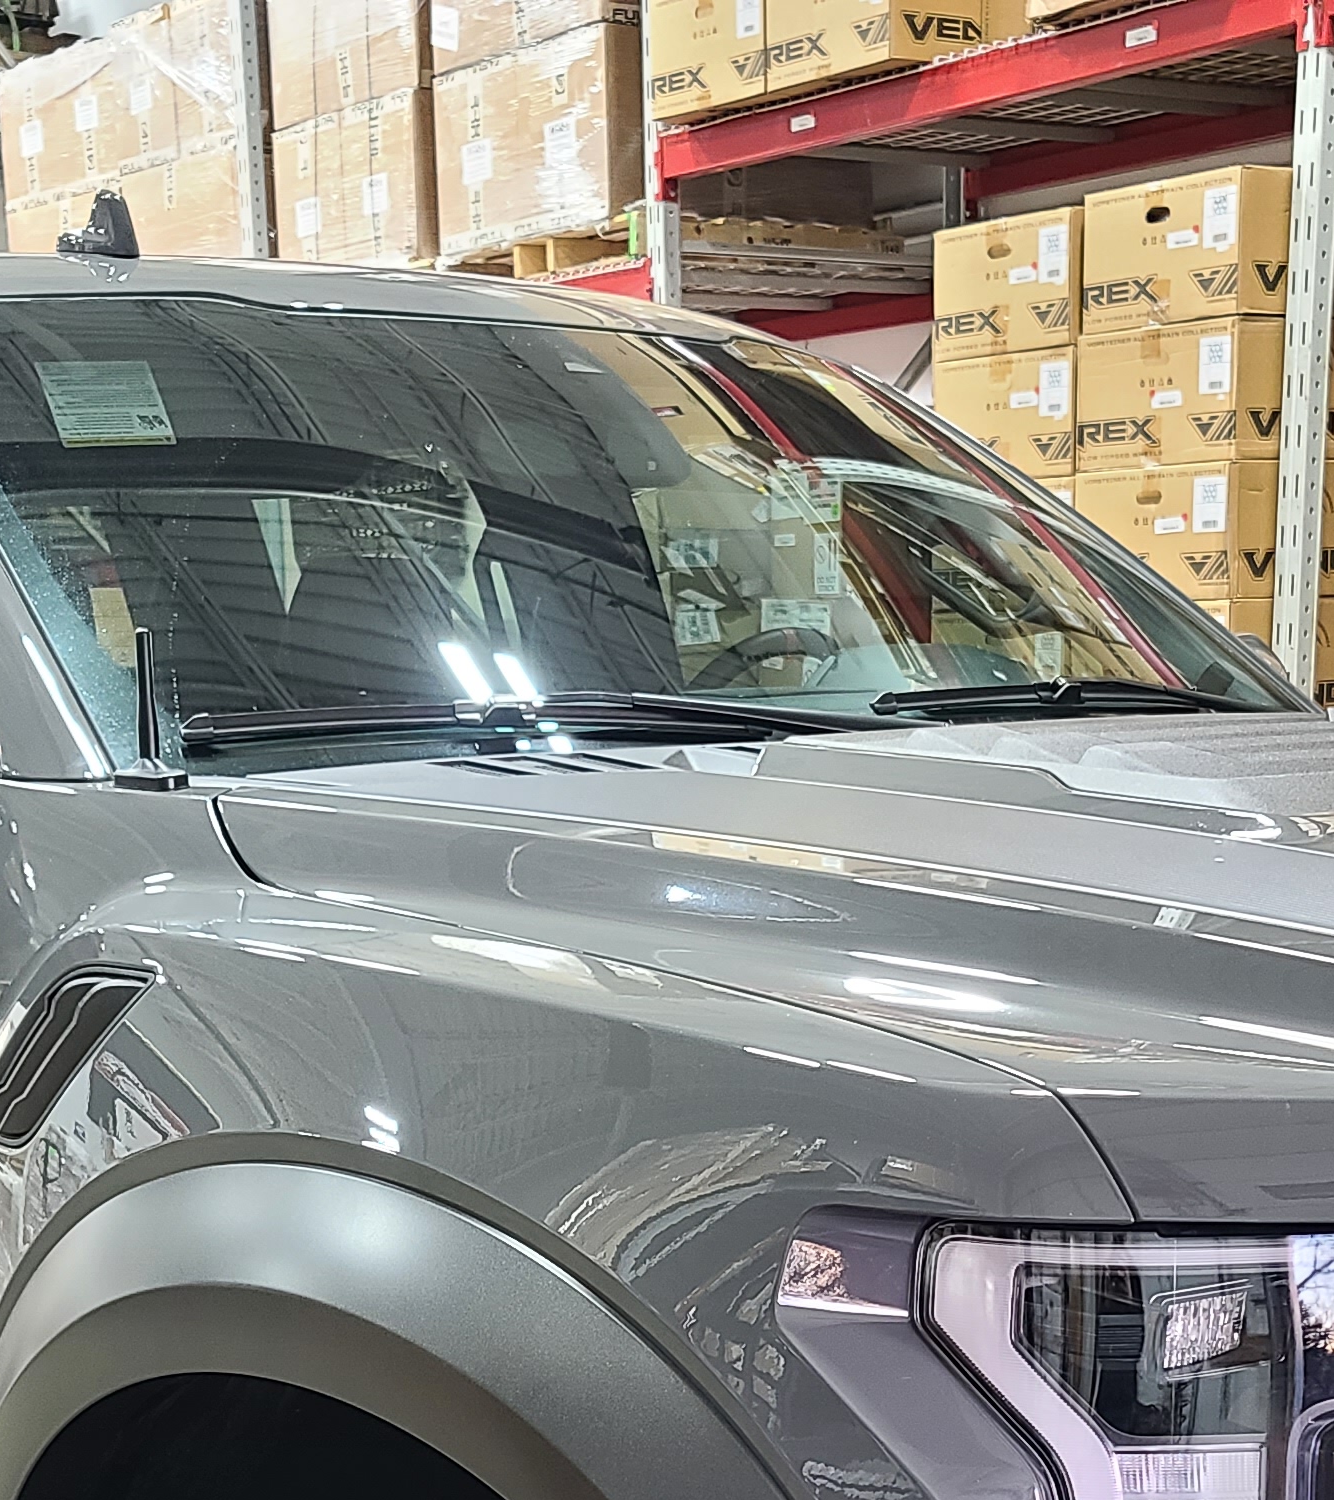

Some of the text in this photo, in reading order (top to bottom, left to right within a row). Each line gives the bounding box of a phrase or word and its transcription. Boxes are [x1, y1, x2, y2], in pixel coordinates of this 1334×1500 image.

[902, 11, 982, 43] VEN
[1083, 277, 1157, 312] REX
[935, 308, 1003, 341] REX
[1181, 325, 1228, 337] COLLECTION
[1078, 417, 1160, 449] REX
